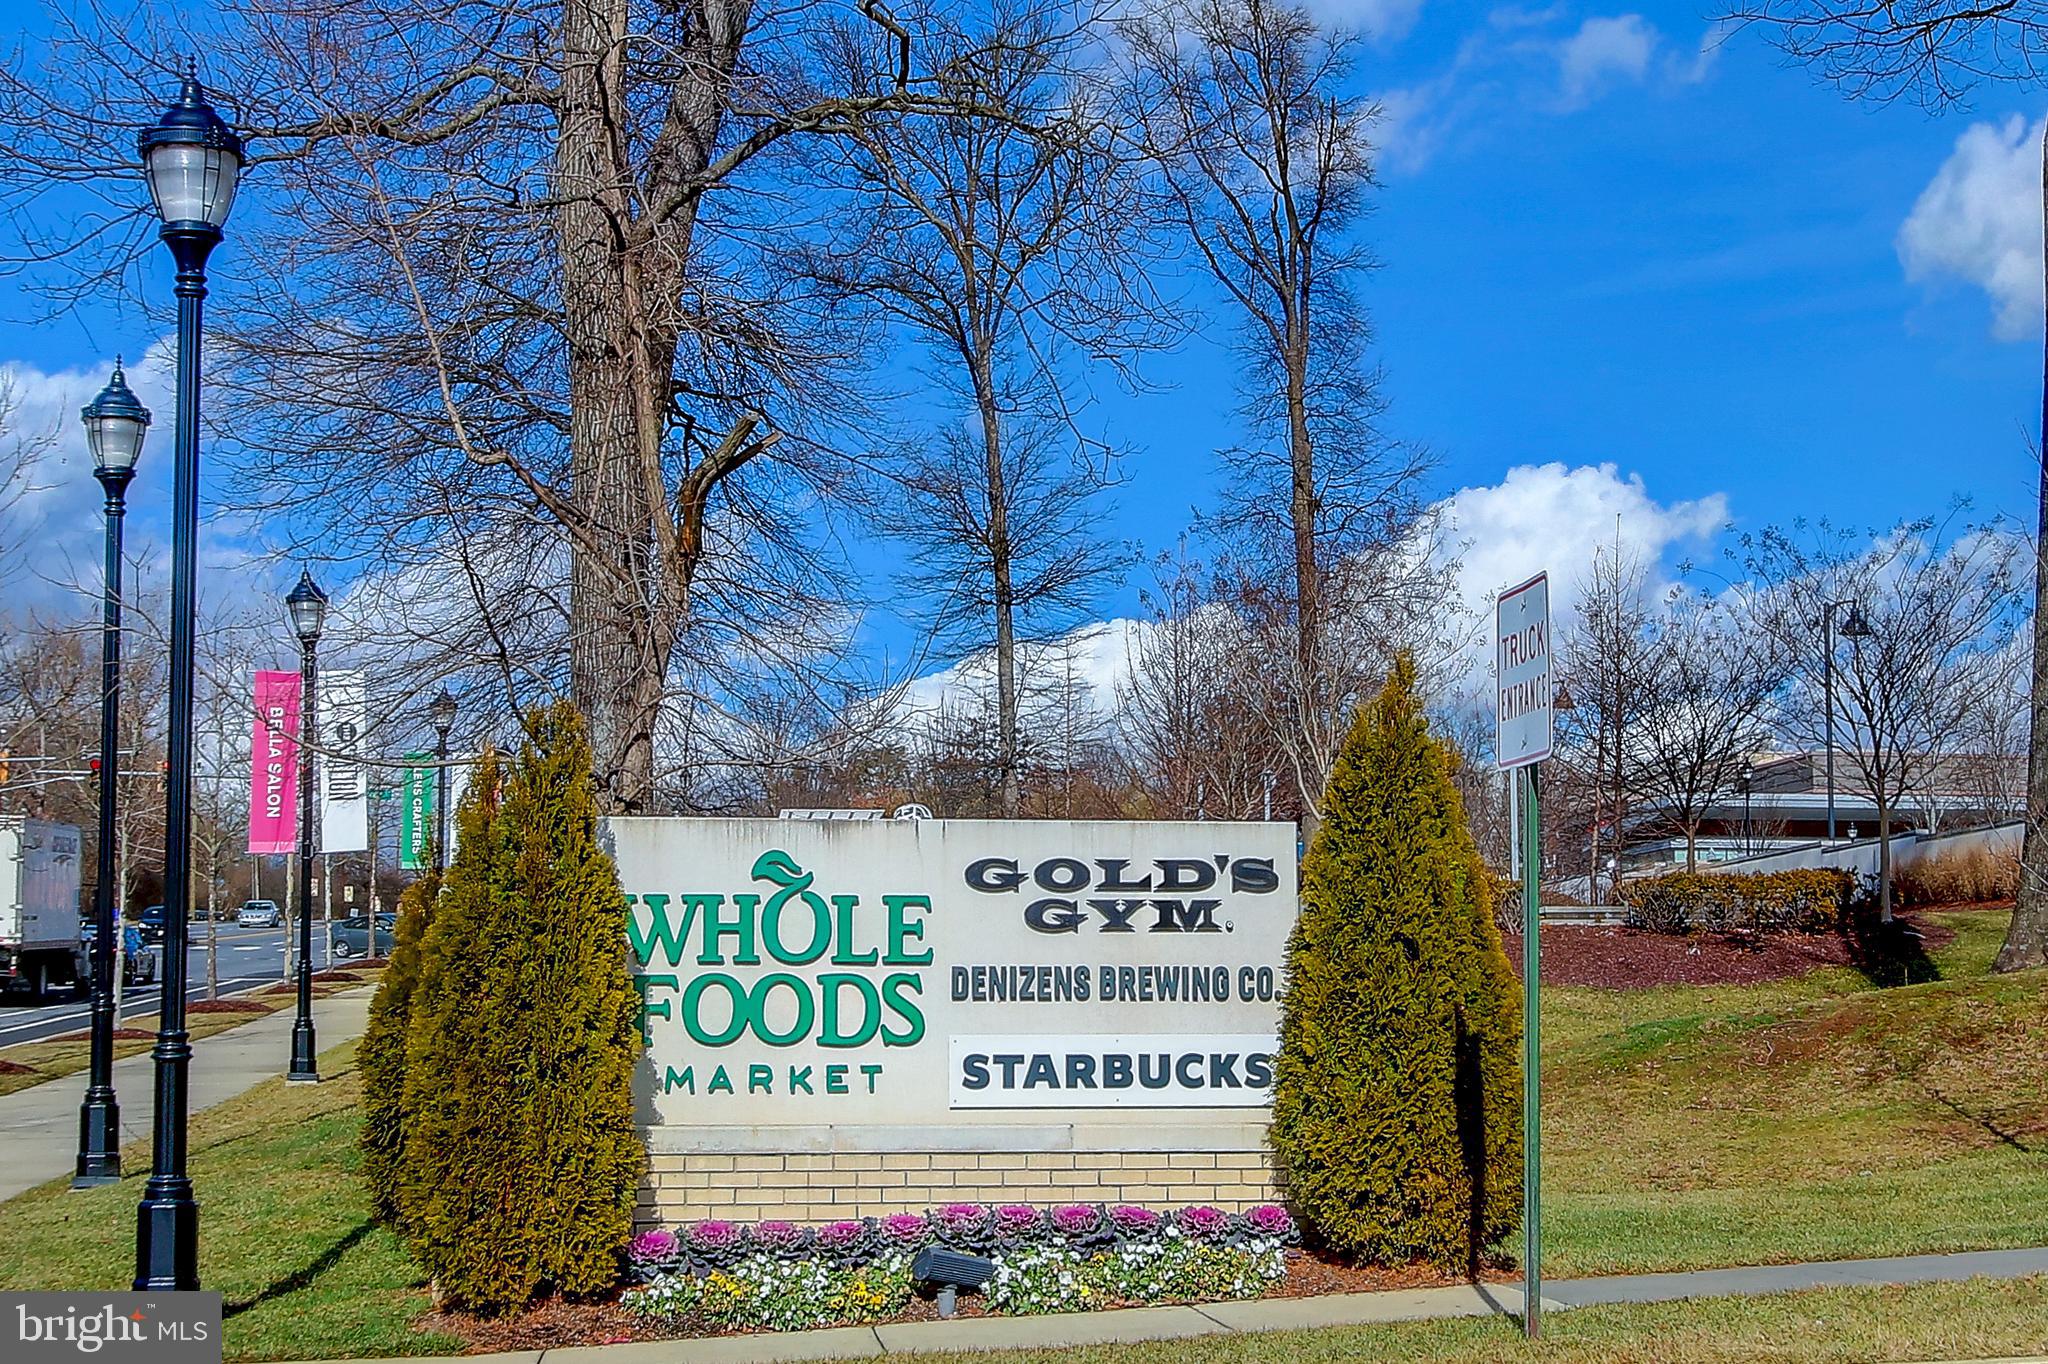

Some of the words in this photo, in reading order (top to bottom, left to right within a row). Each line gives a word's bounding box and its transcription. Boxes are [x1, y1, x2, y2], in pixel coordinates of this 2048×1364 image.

[1502, 620, 1545, 671] TRUCK
[1501, 674, 1547, 722] ENTRANCE
[268, 706, 284, 758] BELLA
[266, 763, 283, 818] SALON
[411, 797, 423, 854] CRAFTERS
[964, 854, 1280, 894] GOLD'S
[625, 884, 934, 967] WHOLE
[1023, 898, 1234, 934] GYM.
[951, 965, 1092, 1003] DENIZENS
[1099, 965, 1230, 1003] BREWING
[1238, 965, 1282, 1003] CO.
[633, 973, 926, 1047] FOODS
[664, 1063, 884, 1095] MARKET
[961, 1052, 1274, 1090] STARBUCKS
